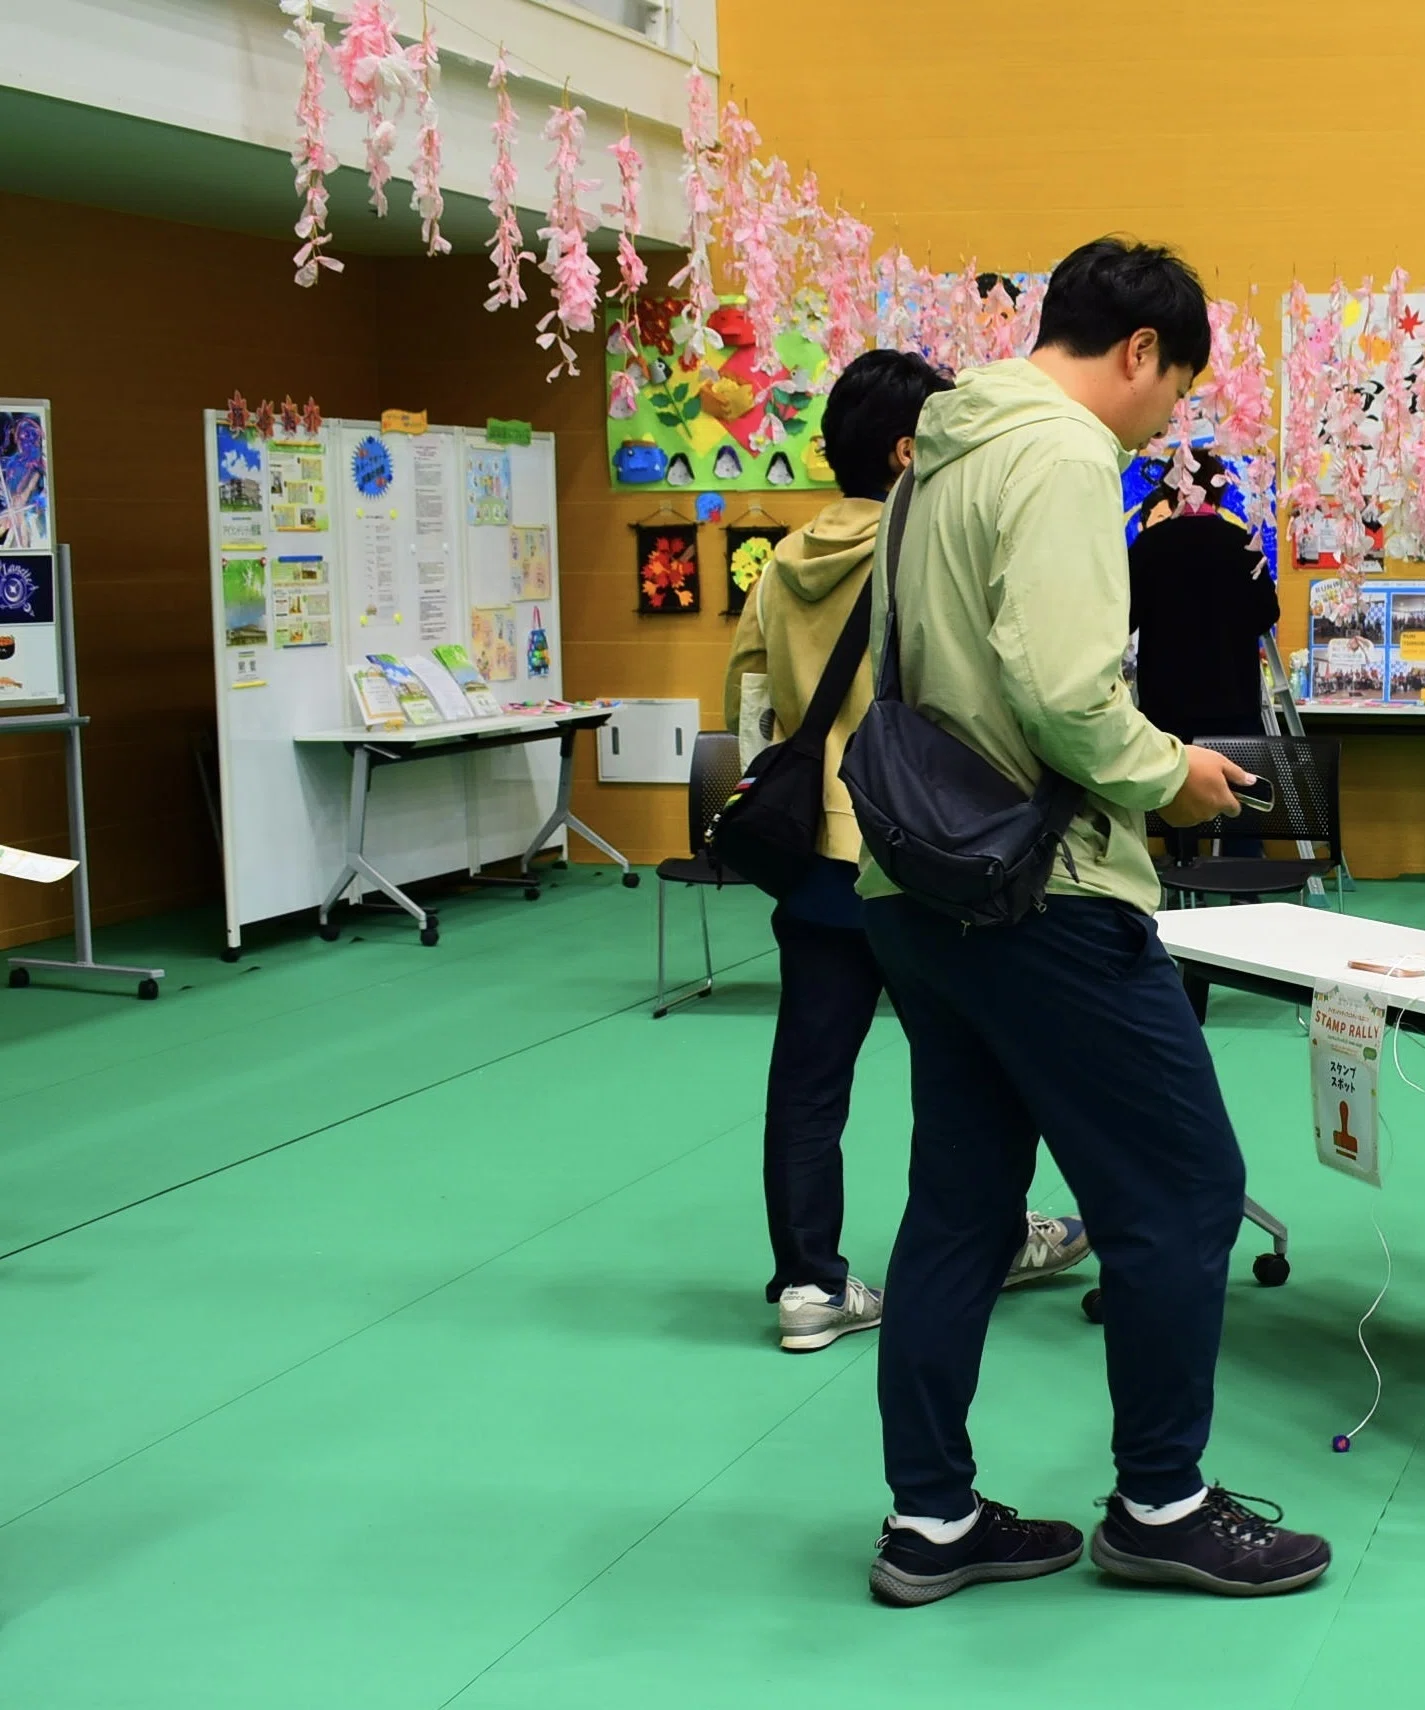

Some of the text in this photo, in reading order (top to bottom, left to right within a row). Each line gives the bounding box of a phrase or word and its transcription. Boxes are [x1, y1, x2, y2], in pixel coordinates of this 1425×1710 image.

[1315, 1010, 1346, 1034] STAMP
[1349, 1024, 1379, 1039] RALLY
[1330, 1061, 1357, 1079] スタンプ
[1331, 1077, 1356, 1093] スポット
[1021, 1243, 1048, 1267] N
